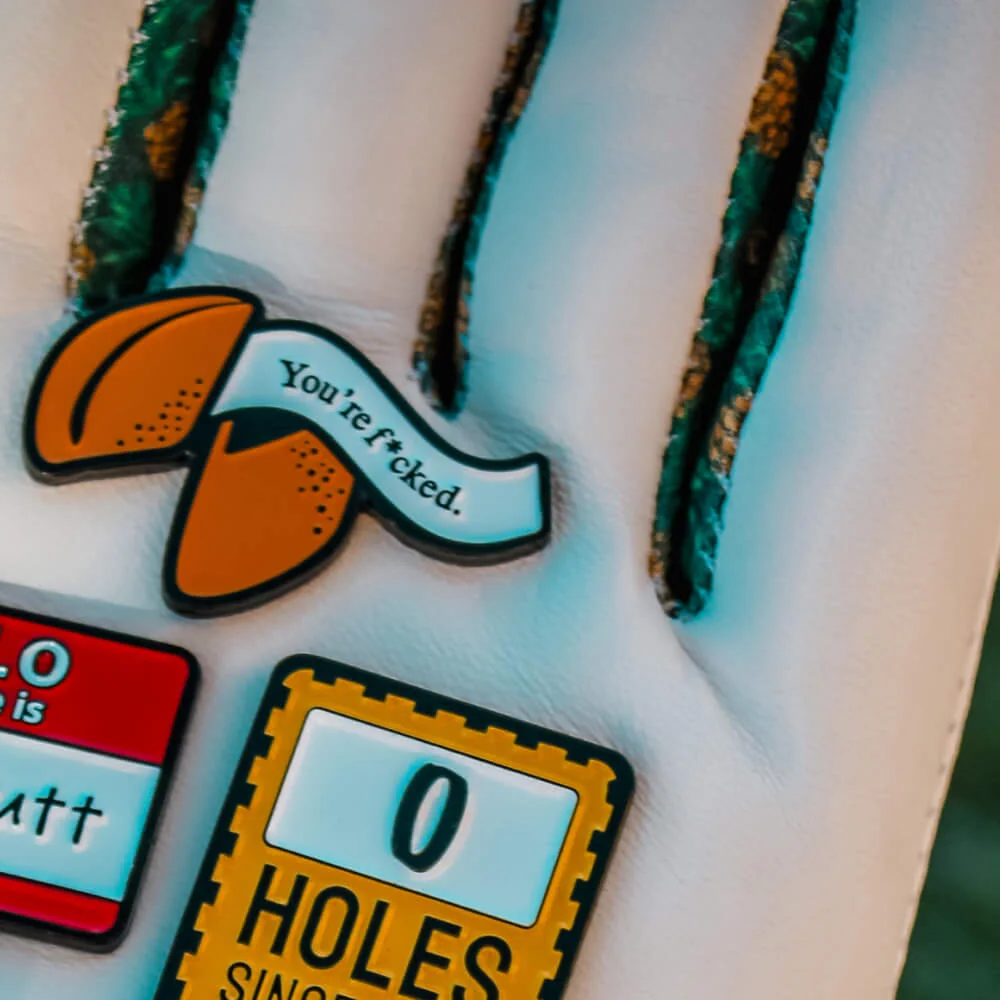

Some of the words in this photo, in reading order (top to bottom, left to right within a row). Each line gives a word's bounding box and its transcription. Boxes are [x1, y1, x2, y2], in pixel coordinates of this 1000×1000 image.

[280, 359, 372, 431] You're
[11, 690, 46, 726] is
[391, 762, 469, 873] 0
